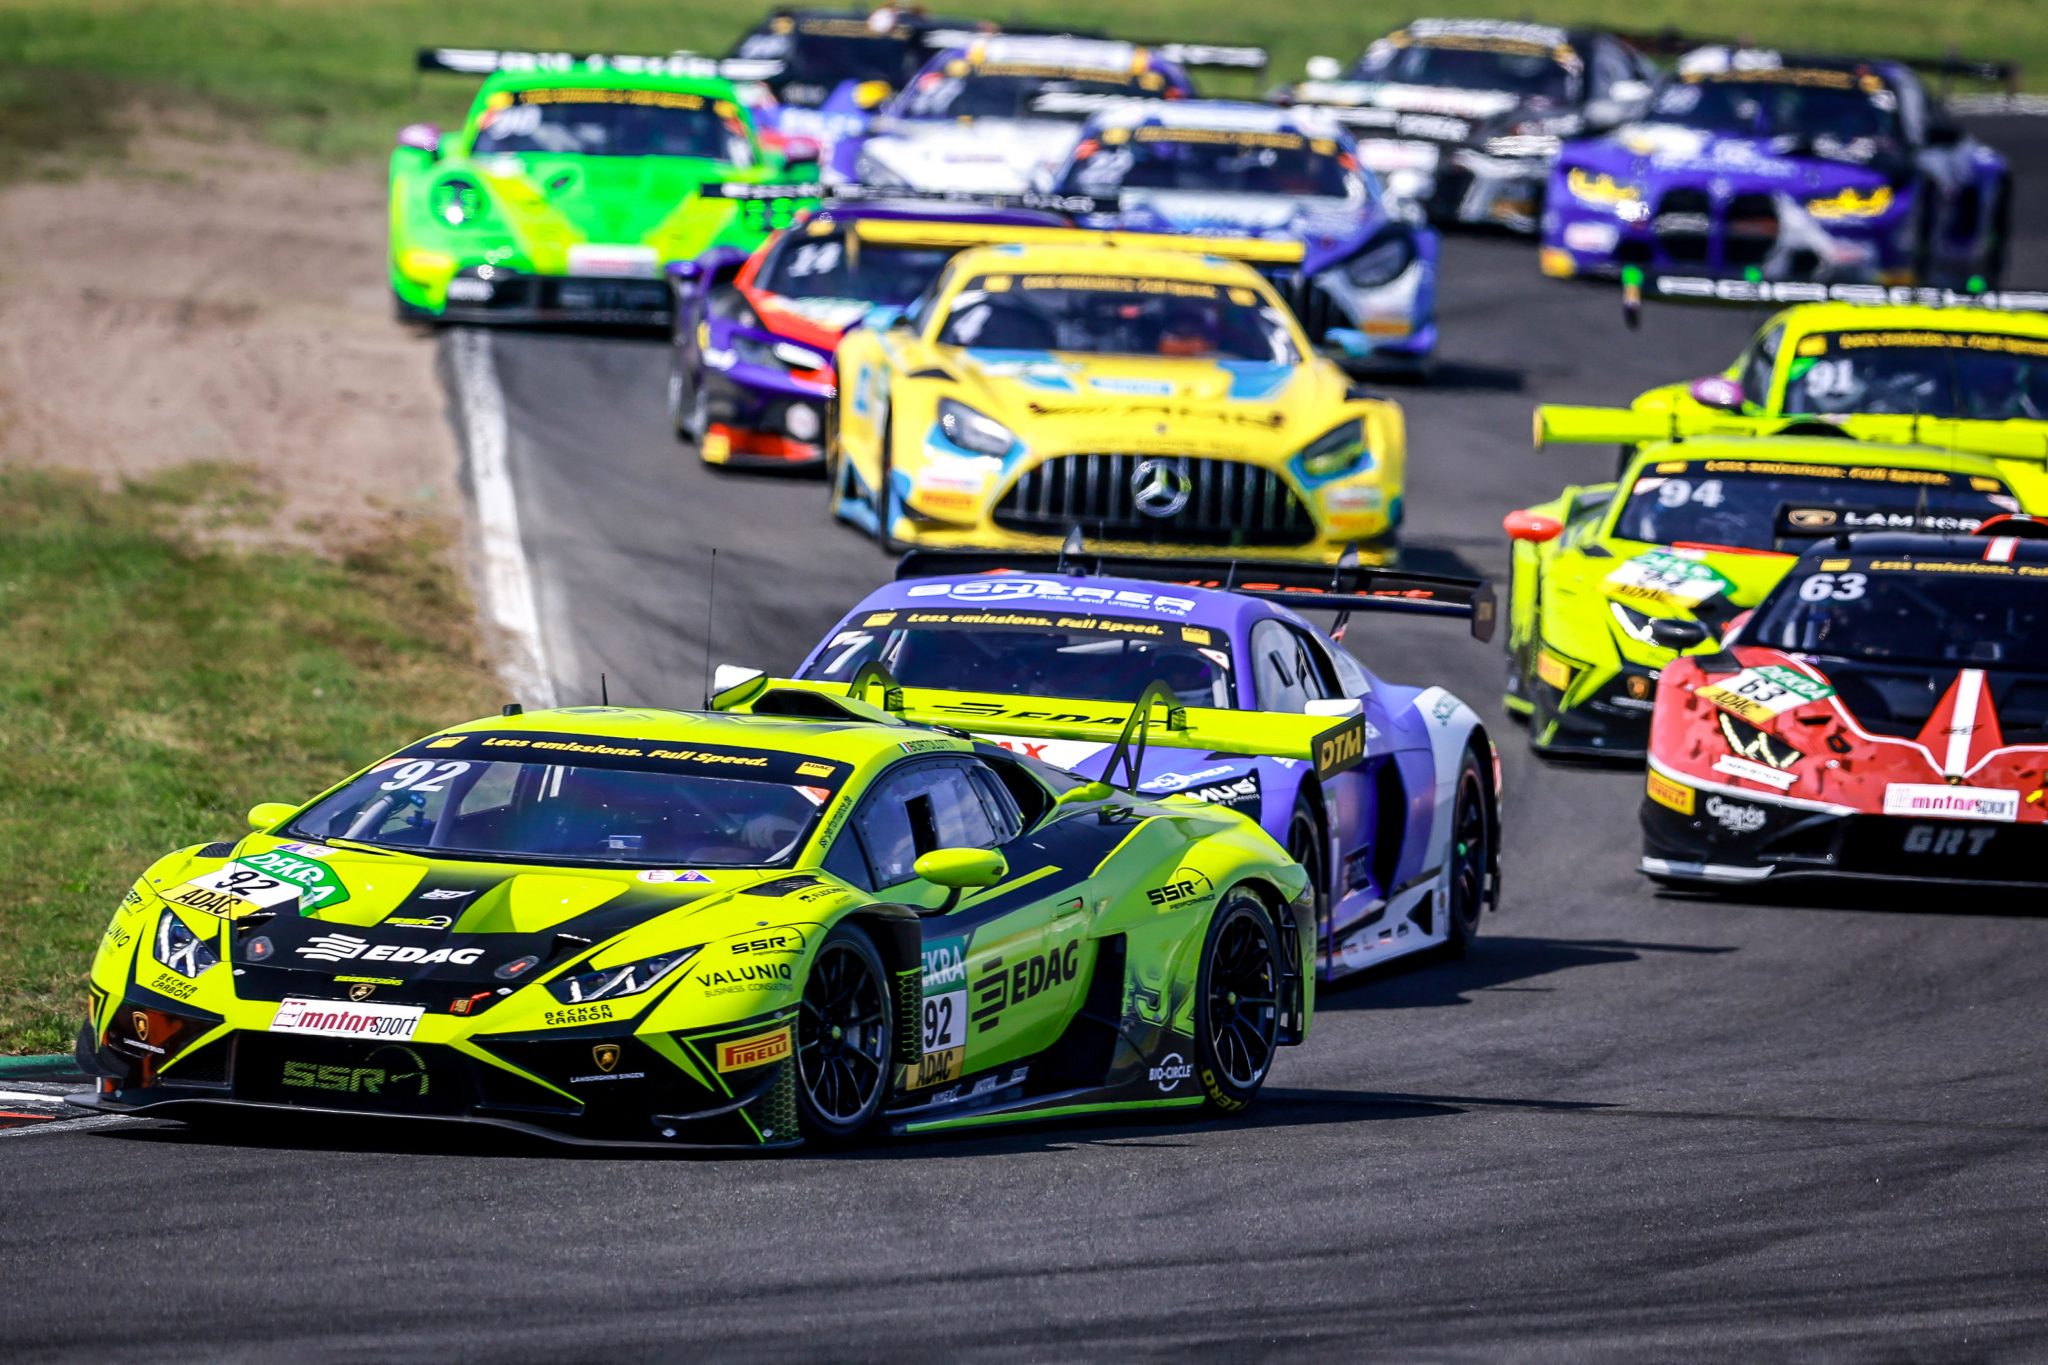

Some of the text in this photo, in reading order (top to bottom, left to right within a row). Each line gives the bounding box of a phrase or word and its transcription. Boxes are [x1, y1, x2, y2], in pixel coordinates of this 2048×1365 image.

[1807, 360, 1854, 397] 91
[1657, 480, 1725, 508] 94
[907, 583, 1197, 613] SCHERER
[1799, 573, 1867, 601] 63
[907, 612, 950, 623] Less
[951, 613, 1054, 627] emissions.
[1057, 617, 1097, 630] Full
[1098, 620, 1165, 636] Speed.
[1712, 691, 1761, 715] ADAC
[1738, 679, 1787, 702] 63
[481, 737, 768, 768] Less emissions. Full Speed.
[1319, 726, 1363, 772] DTM
[380, 760, 472, 793] 92
[1903, 824, 1997, 856] GRT
[215, 871, 280, 897] 92
[243, 853, 337, 909] DEKRA
[1147, 880, 1196, 906] SSR
[174, 888, 243, 916] ADAC
[361, 944, 486, 965] EDAG
[731, 936, 786, 955] SSR
[696, 962, 793, 988] VALUNIQ
[922, 945, 965, 987] EKRA
[1010, 938, 1079, 1006] EDAG
[151, 979, 192, 1000] CARBON
[157, 973, 199, 994] BECKER
[704, 984, 745, 998] BUSINESS
[298, 1011, 417, 1036] motorsport
[544, 1004, 611, 1019] BECKER
[546, 1011, 613, 1025] CARBON
[924, 996, 953, 1049] 92
[725, 1032, 787, 1067] PIRELLI
[281, 1060, 386, 1094] SSR
[916, 1050, 954, 1087] ADAC
[1149, 1063, 1192, 1081] BIO-CIRCLE
